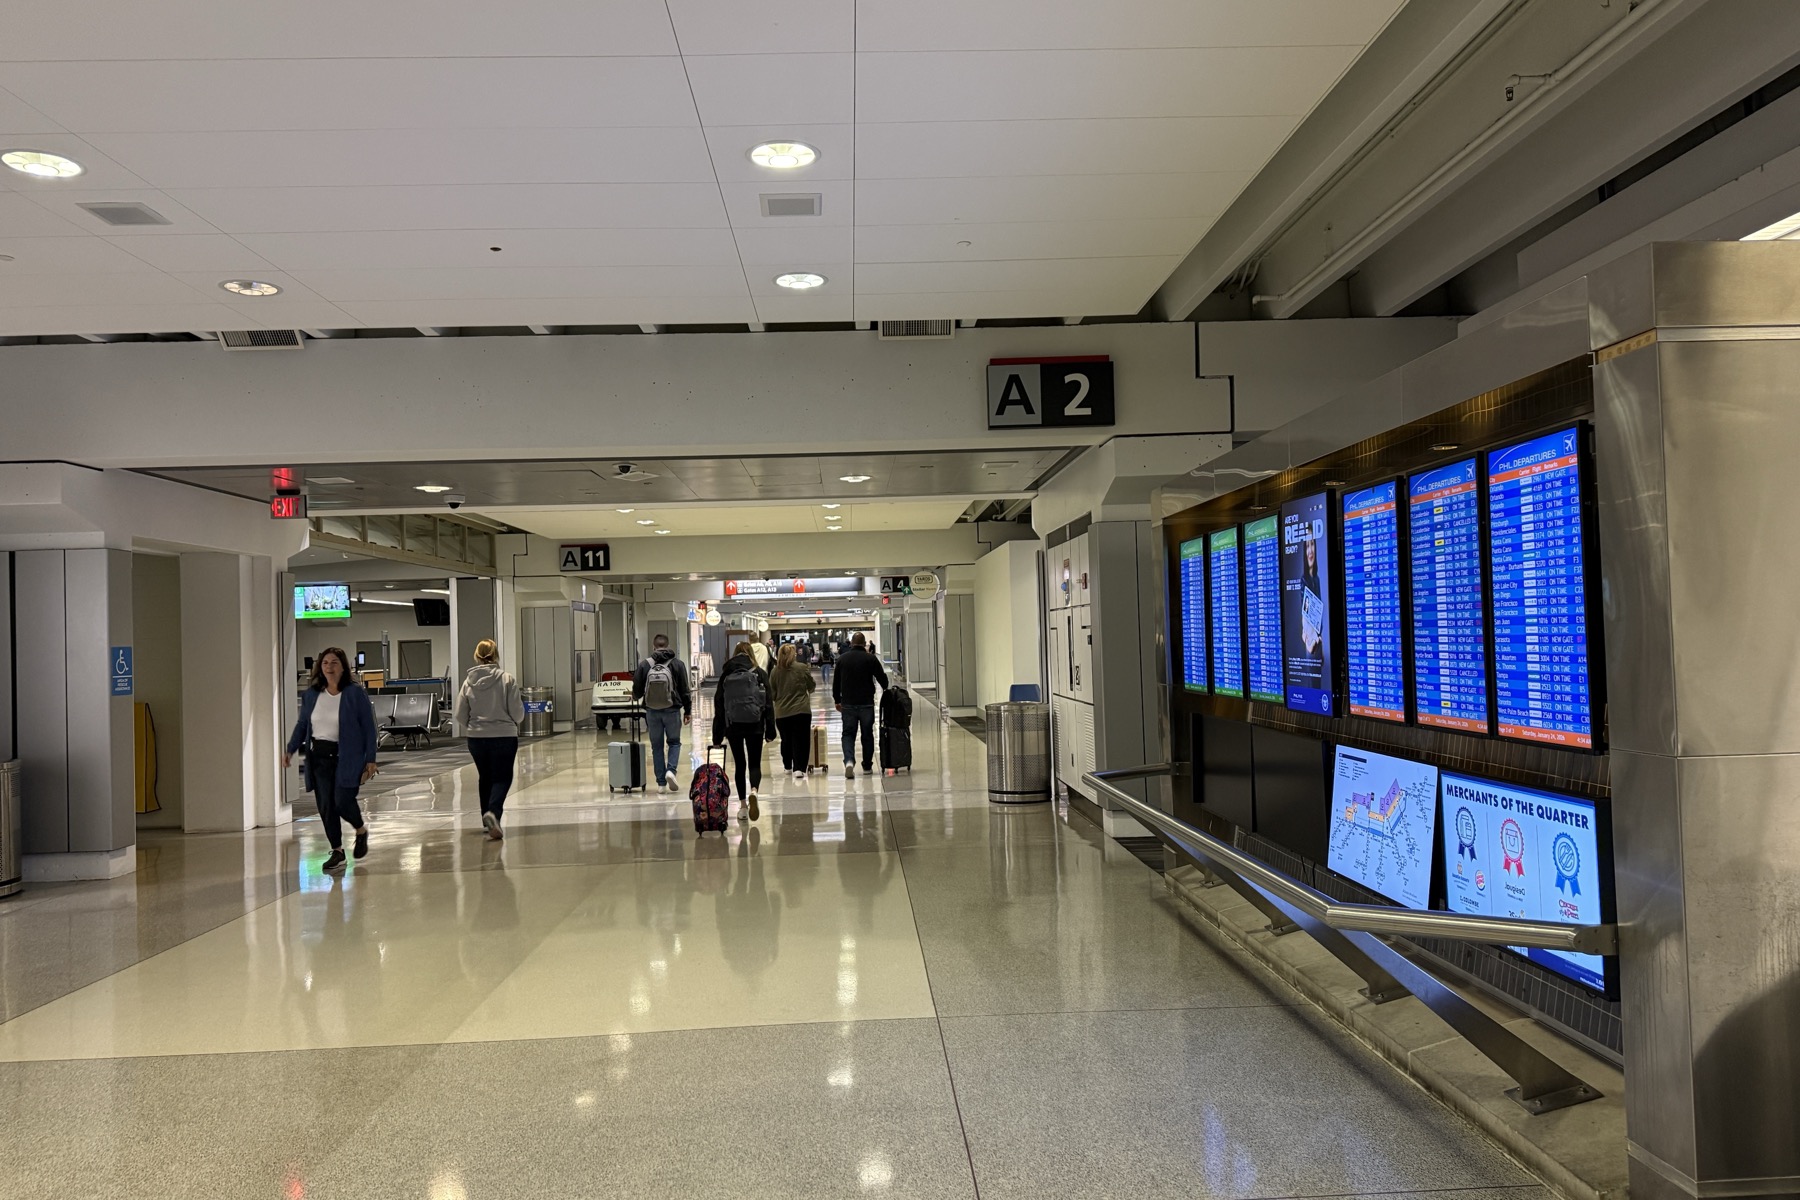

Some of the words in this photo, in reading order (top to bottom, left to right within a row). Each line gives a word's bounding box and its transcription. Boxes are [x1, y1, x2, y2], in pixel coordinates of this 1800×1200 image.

[995, 374, 1036, 416] A
[1064, 373, 1092, 416] 2
[1499, 463, 1512, 471] PHL
[1513, 449, 1556, 468] DEPARTURES
[1544, 471, 1553, 480] NEW
[1554, 468, 1565, 477] GATE
[1428, 476, 1461, 491] DEPARTURES
[1552, 488, 1562, 497] TIME
[274, 498, 300, 517] EXIT
[1359, 496, 1384, 509] DEPARTURES
[1553, 508, 1563, 516] TIME
[1285, 522, 1312, 545] REAL
[1313, 519, 1323, 539] ID
[1554, 527, 1564, 535] TIME
[1285, 545, 1298, 554] READY?
[562, 551, 578, 567] A
[585, 550, 604, 567] 11
[882, 580, 891, 590] A
[897, 580, 904, 590] 4
[1446, 784, 1499, 807] MERCHANTS
[1501, 797, 1514, 811] OF
[1516, 800, 1534, 816] THE
[1537, 805, 1589, 830] QUARTER
